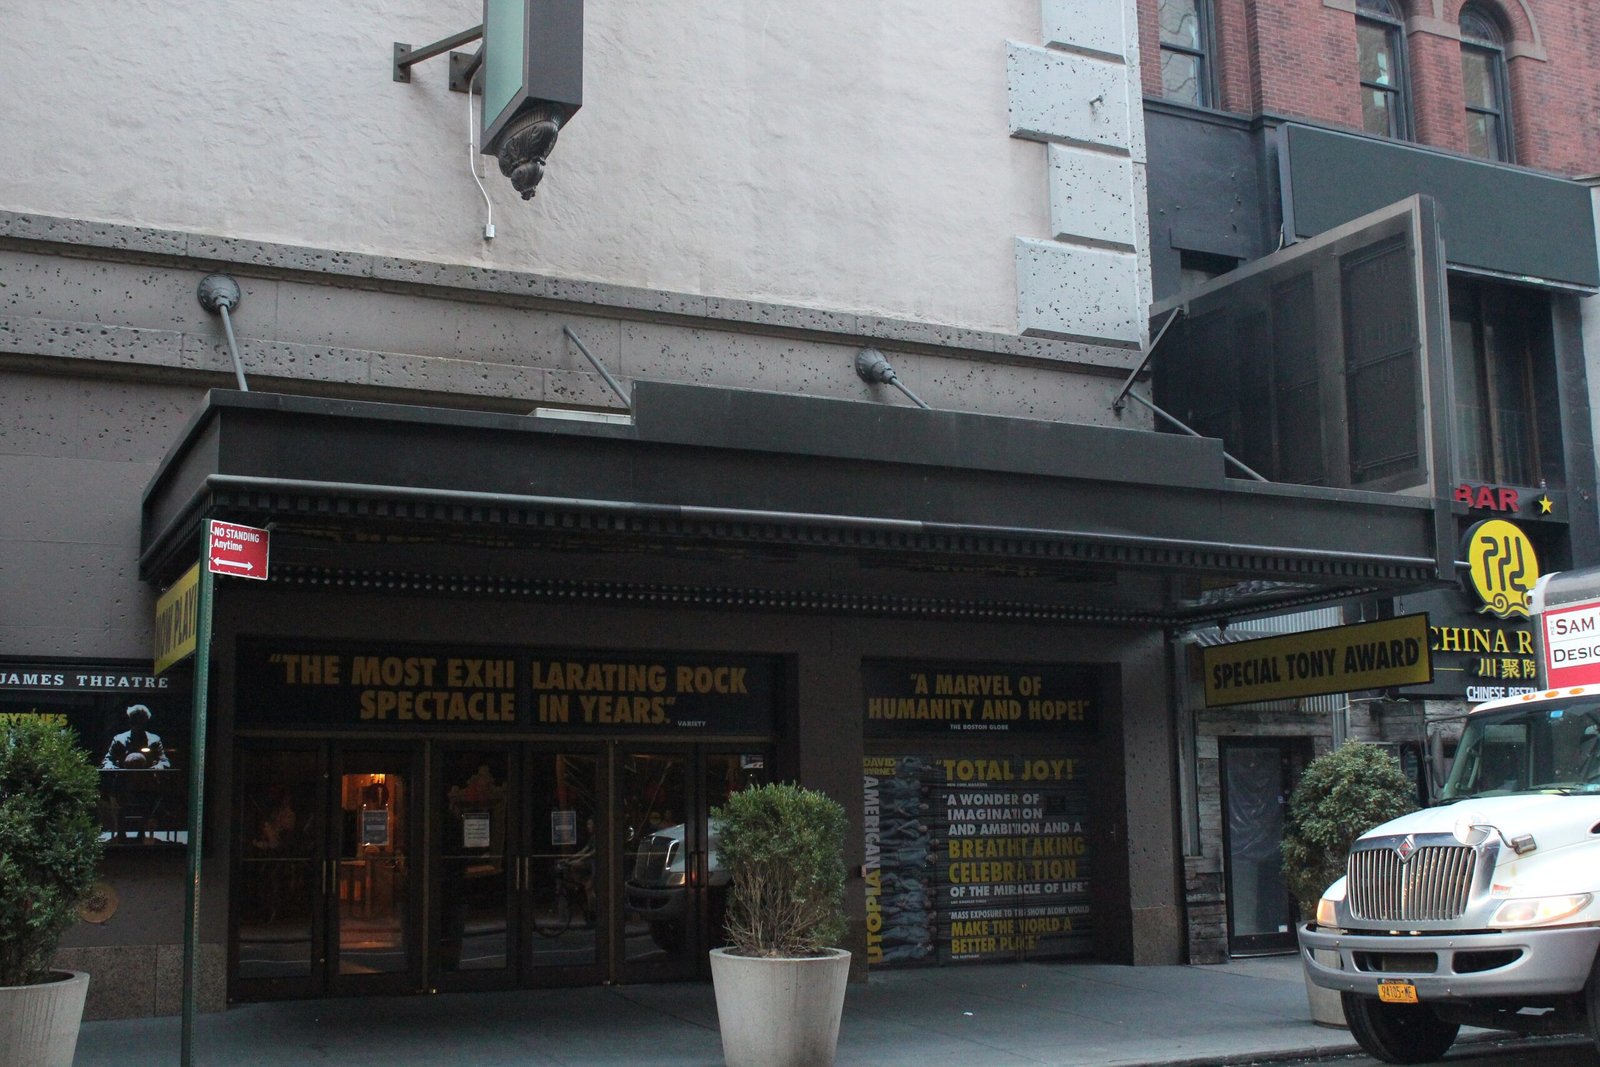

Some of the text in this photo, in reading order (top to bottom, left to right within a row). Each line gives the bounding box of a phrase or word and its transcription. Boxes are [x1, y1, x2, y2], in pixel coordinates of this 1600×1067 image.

[1456, 484, 1519, 512] BAR
[214, 527, 260, 543] NO STANDING
[214, 538, 243, 551] Anytime
[1556, 617, 1595, 635] SAM
[1212, 637, 1420, 690] SPECIAL TONY AWARD
[0, 673, 169, 688] JAMES THEATRE
[269, 655, 748, 694] "THE MOST EXHI LARATING ROCK
[910, 673, 1042, 697] "A MARVEL OF
[1466, 686, 1505, 700] CHINESE
[360, 690, 516, 720] SPECTACLE
[539, 694, 569, 723] IN
[868, 697, 975, 720] HUMANITY
[981, 699, 1022, 721] AND
[936, 759, 1014, 781] "TOTAL
[942, 793, 1040, 806] "A WONDER OF
[863, 776, 880, 868] AMERICAN
[947, 808, 1043, 821] IMAGINATION
[948, 821, 1082, 836] AND AMBITION AND A
[950, 886, 966, 898] OF
[969, 885, 990, 897] THE
[993, 883, 1041, 896] MIRACLE
[1044, 883, 1059, 894] OF
[865, 868, 883, 963] UTOPIA
[970, 909, 1003, 919] EXPOSURE
[1004, 909, 1013, 917] TO
[951, 920, 989, 937] MAKE
[992, 919, 1014, 934] THE
[1063, 916, 1072, 931] A
[951, 938, 996, 954] BETTER
